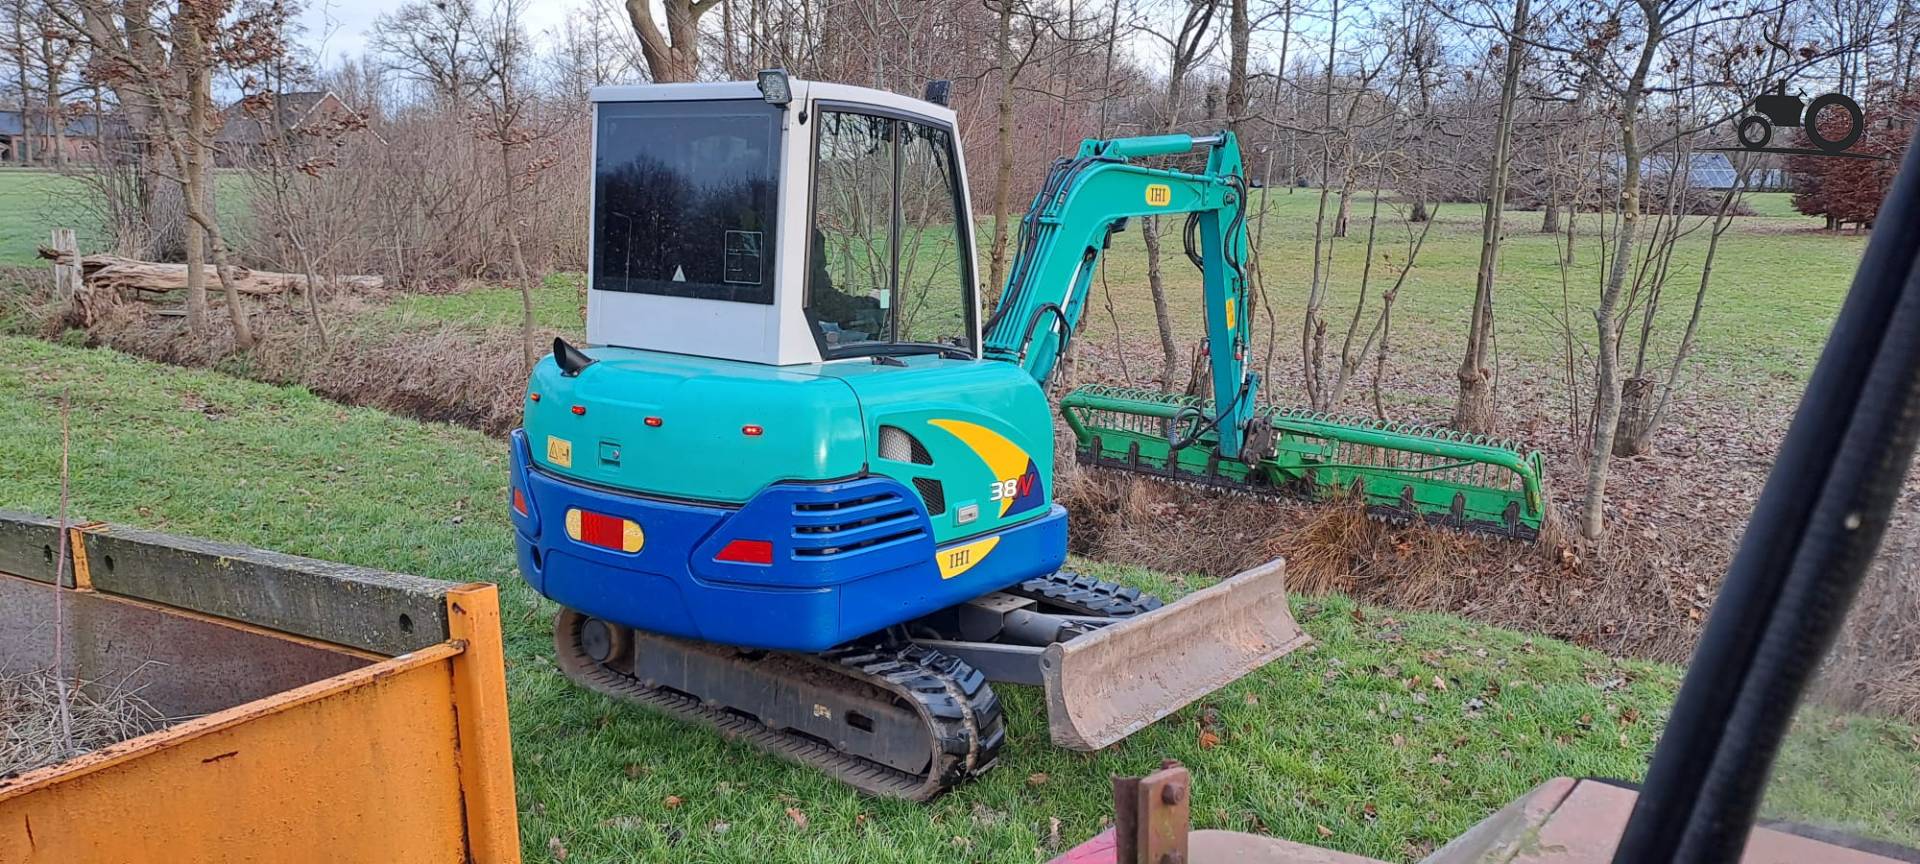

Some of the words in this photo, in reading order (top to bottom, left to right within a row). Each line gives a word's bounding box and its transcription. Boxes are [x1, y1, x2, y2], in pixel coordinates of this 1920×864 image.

[1150, 187, 1166, 202] IHI
[990, 473, 1035, 501] 38N
[949, 549, 970, 569] IHI
